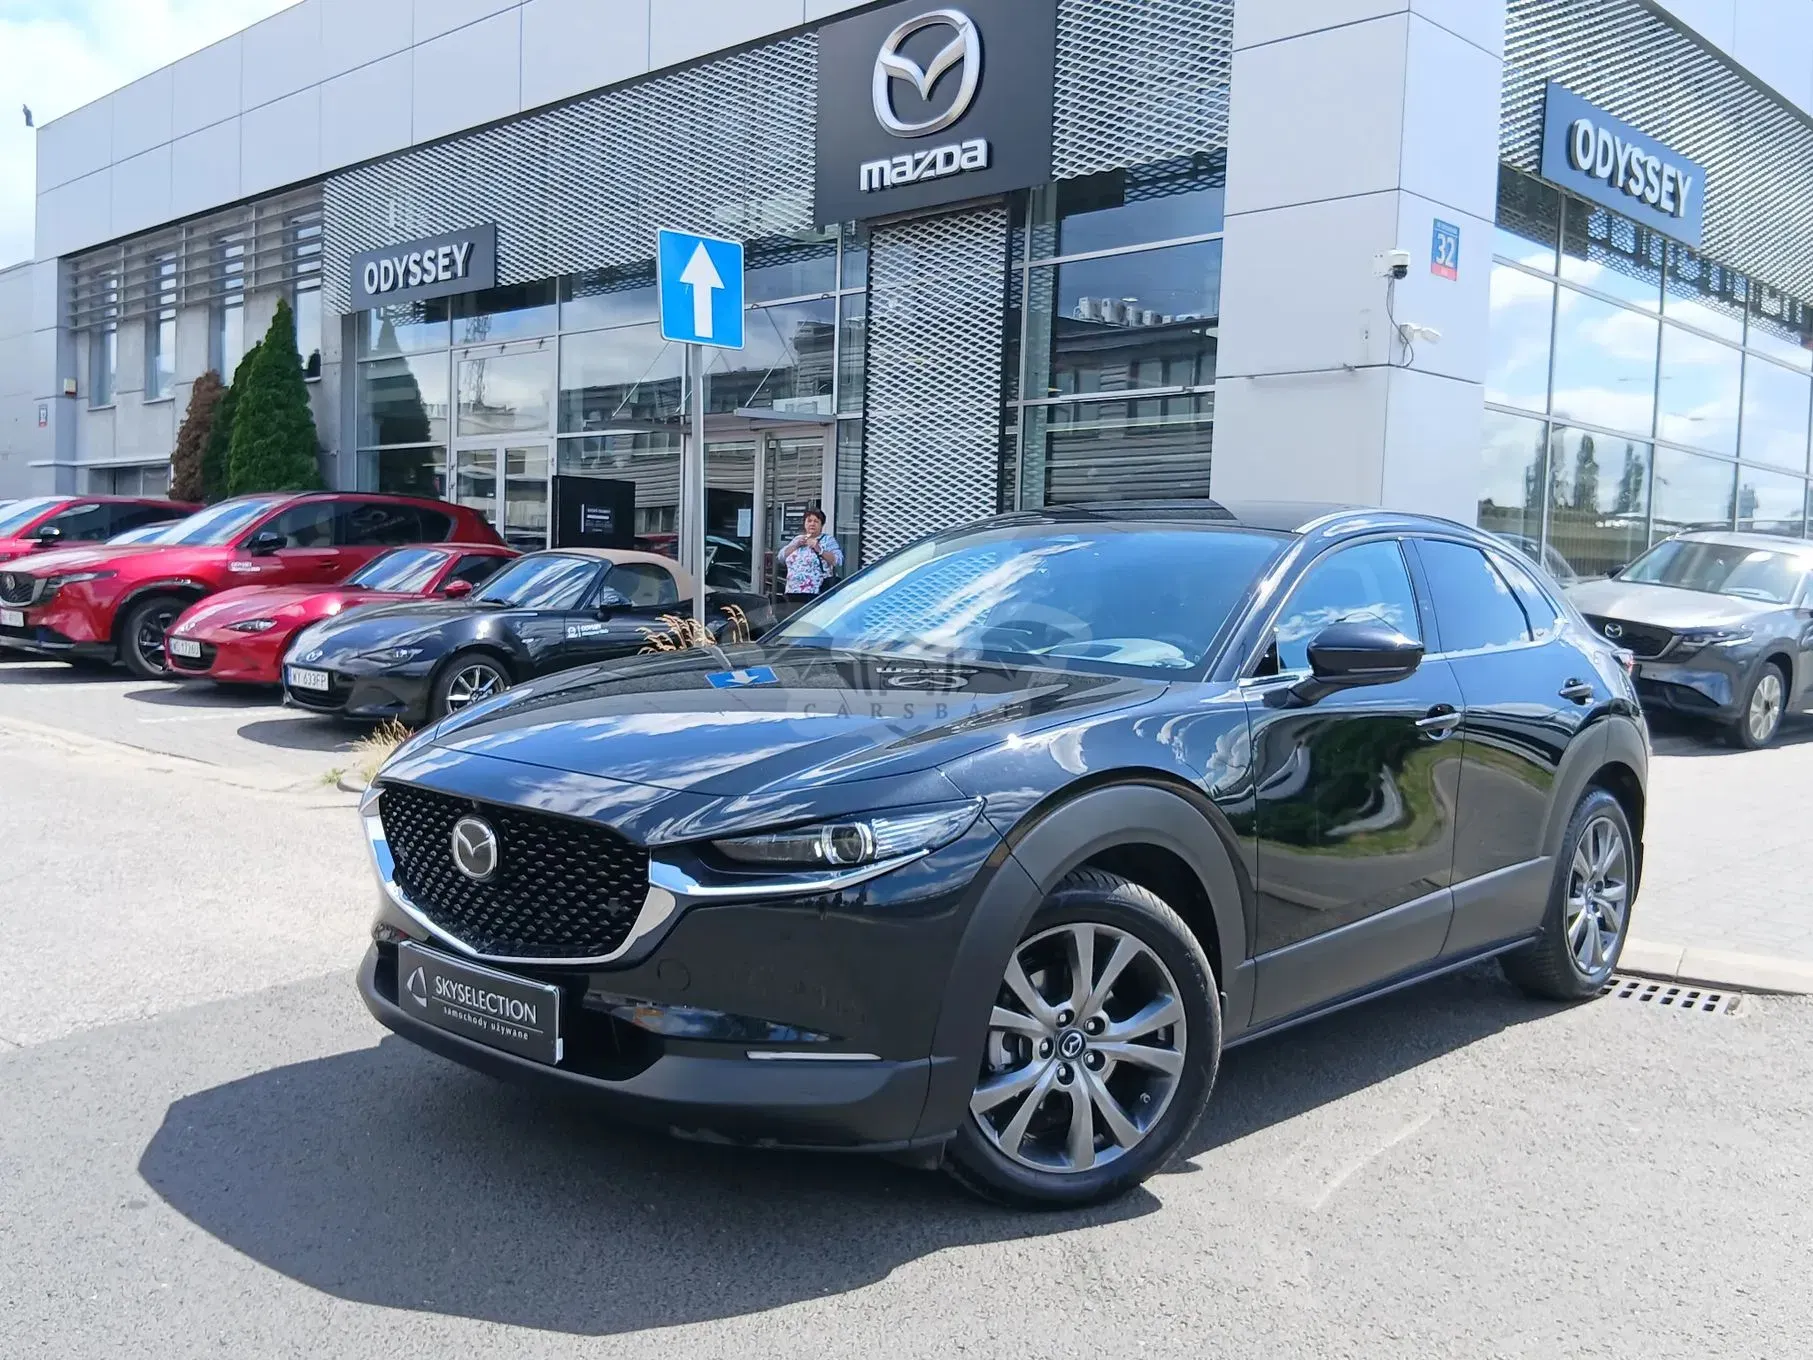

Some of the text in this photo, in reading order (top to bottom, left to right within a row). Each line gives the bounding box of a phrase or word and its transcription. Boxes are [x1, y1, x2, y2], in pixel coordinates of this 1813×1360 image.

[859, 138, 988, 192] mazda
[1573, 118, 1692, 218] ODYSSEY
[364, 241, 471, 295] ODYSSEY
[1436, 231, 1456, 268] 32
[435, 975, 537, 1025] SKYSELECTION
[443, 1006, 529, 1041] samochody używane
